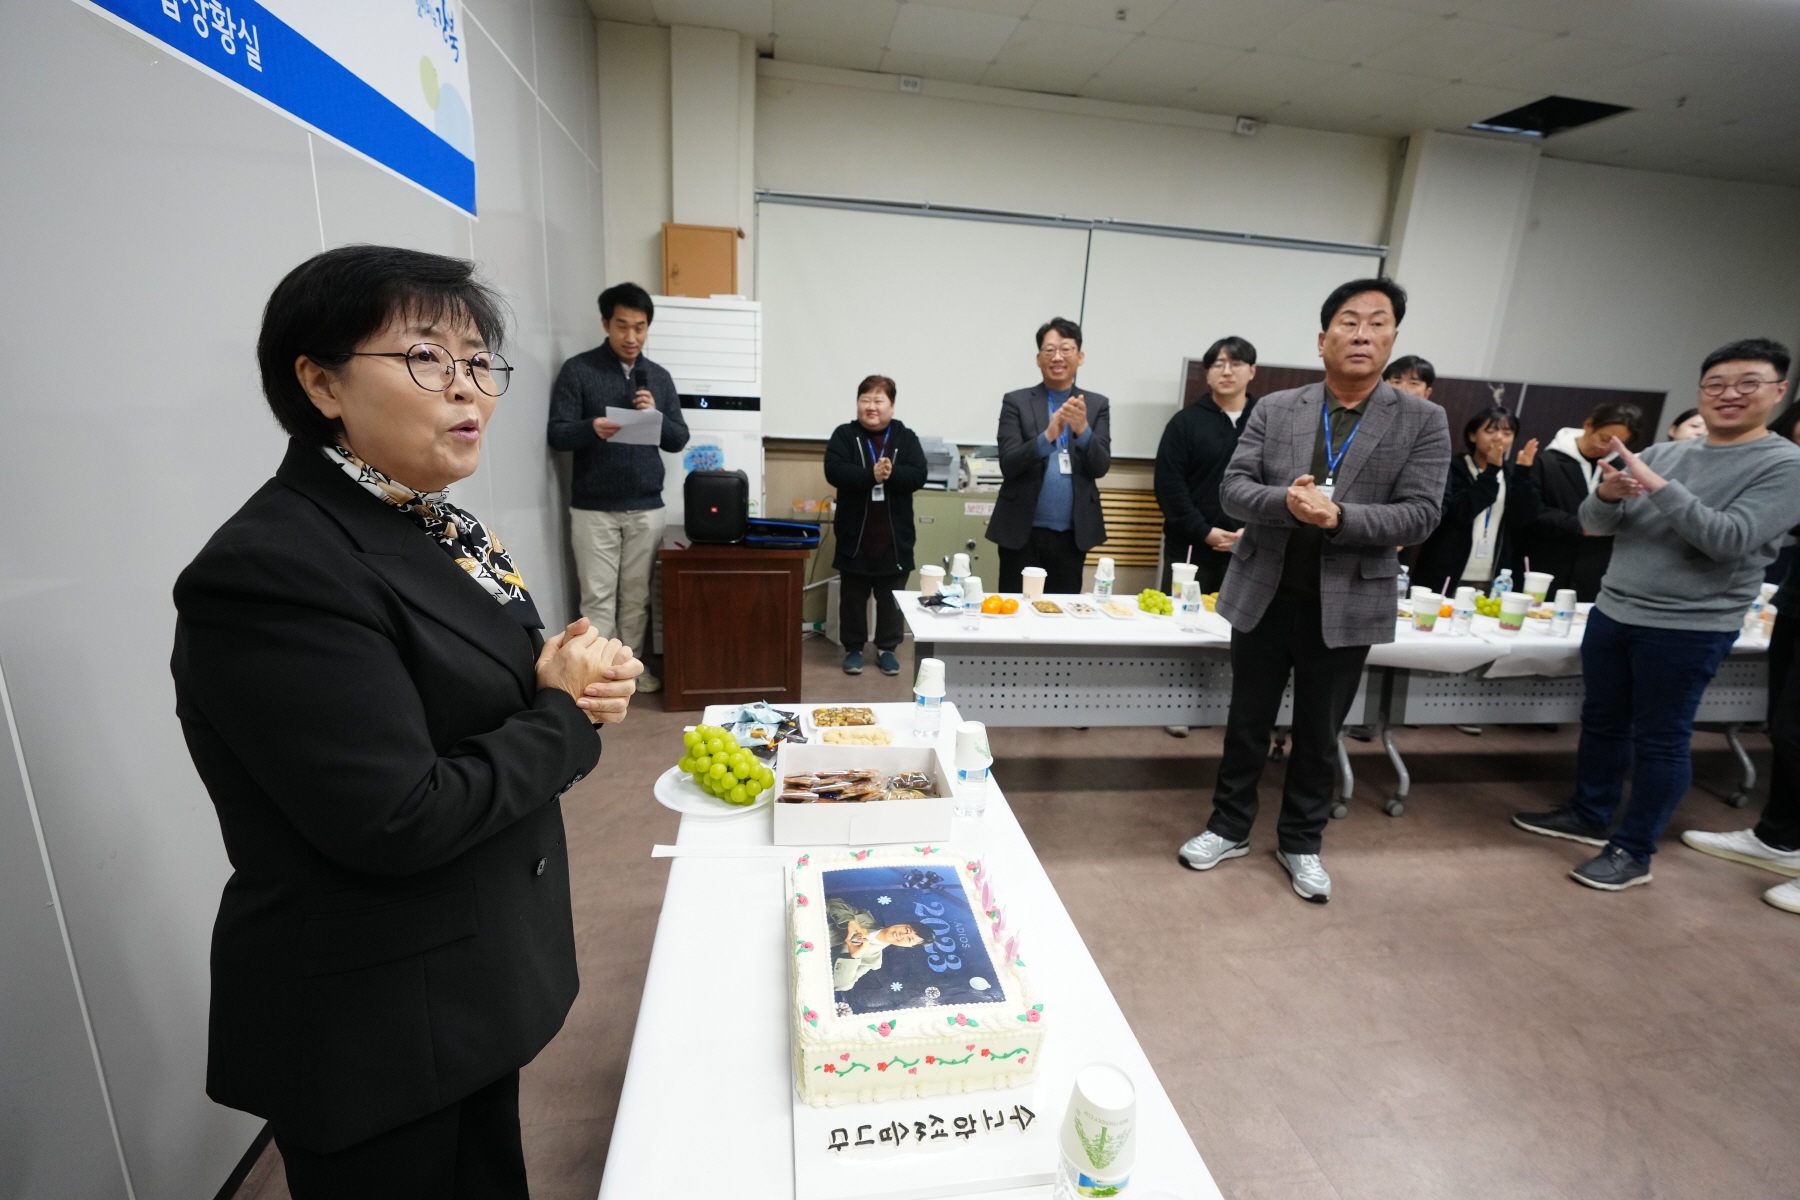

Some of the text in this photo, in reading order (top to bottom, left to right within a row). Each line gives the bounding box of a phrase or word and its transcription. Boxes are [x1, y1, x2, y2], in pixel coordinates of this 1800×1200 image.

[912, 901, 962, 973] 2023
[954, 922, 971, 948] ADIOS
[828, 1104, 1036, 1152] 수고하셨습니다
